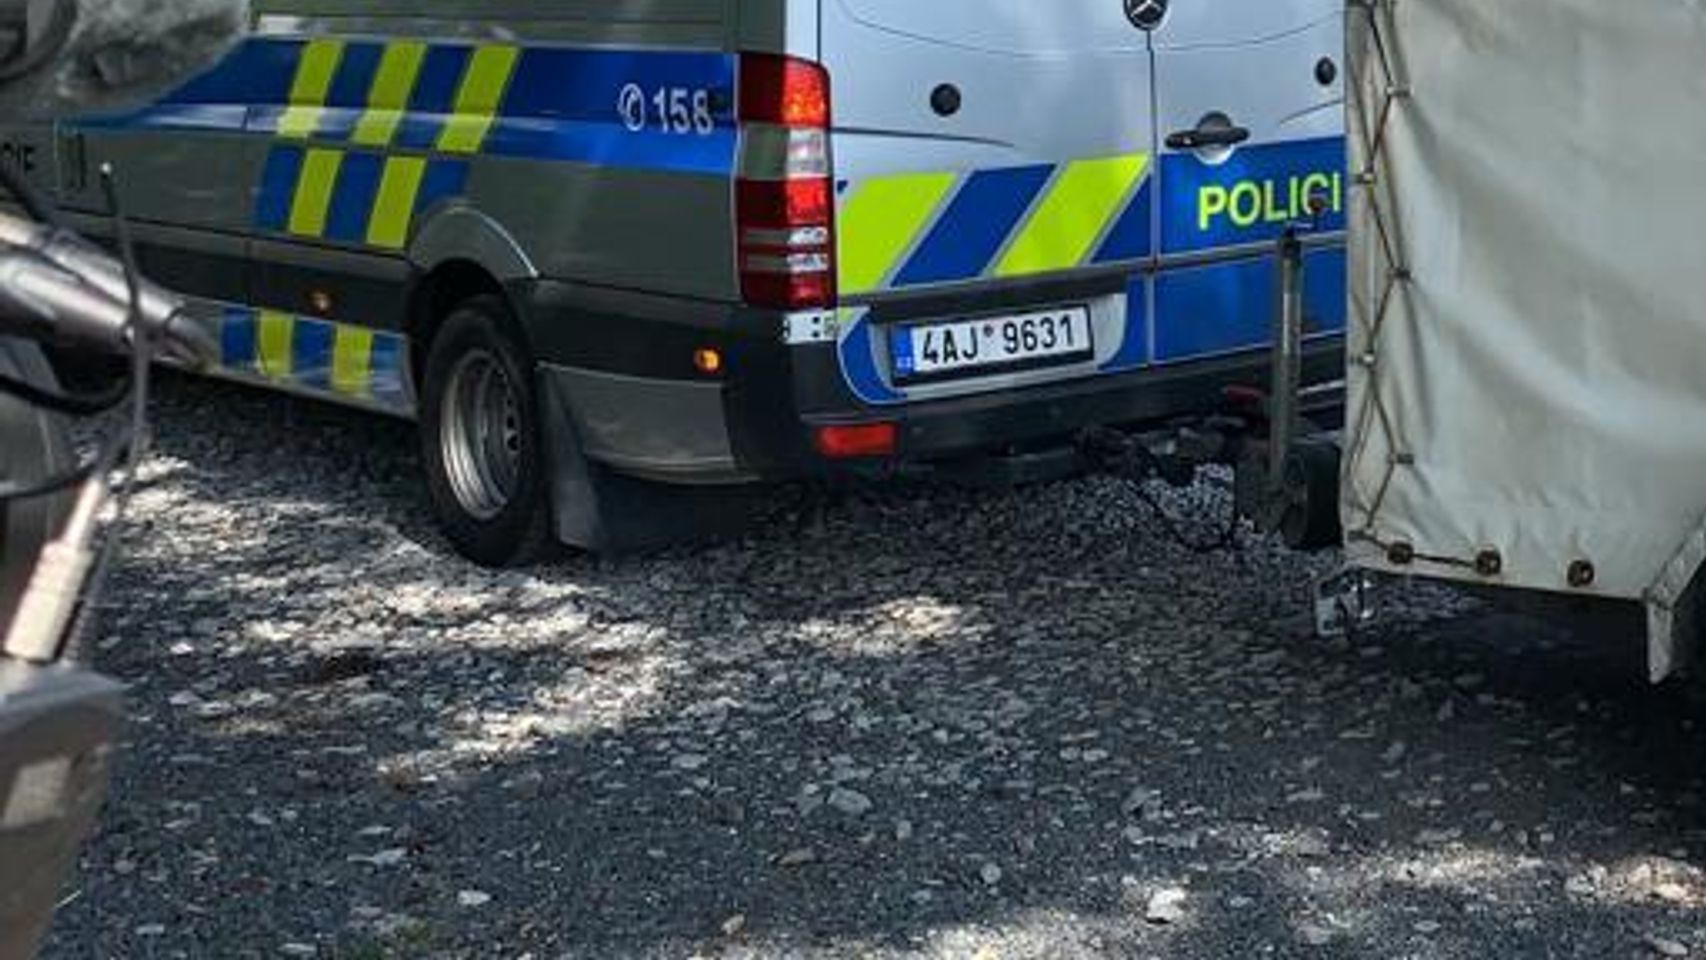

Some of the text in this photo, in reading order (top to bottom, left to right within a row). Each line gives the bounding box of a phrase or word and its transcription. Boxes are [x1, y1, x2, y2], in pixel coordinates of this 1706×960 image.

[653, 86, 714, 135] 158
[922, 314, 1075, 364] 4AJ 9631
